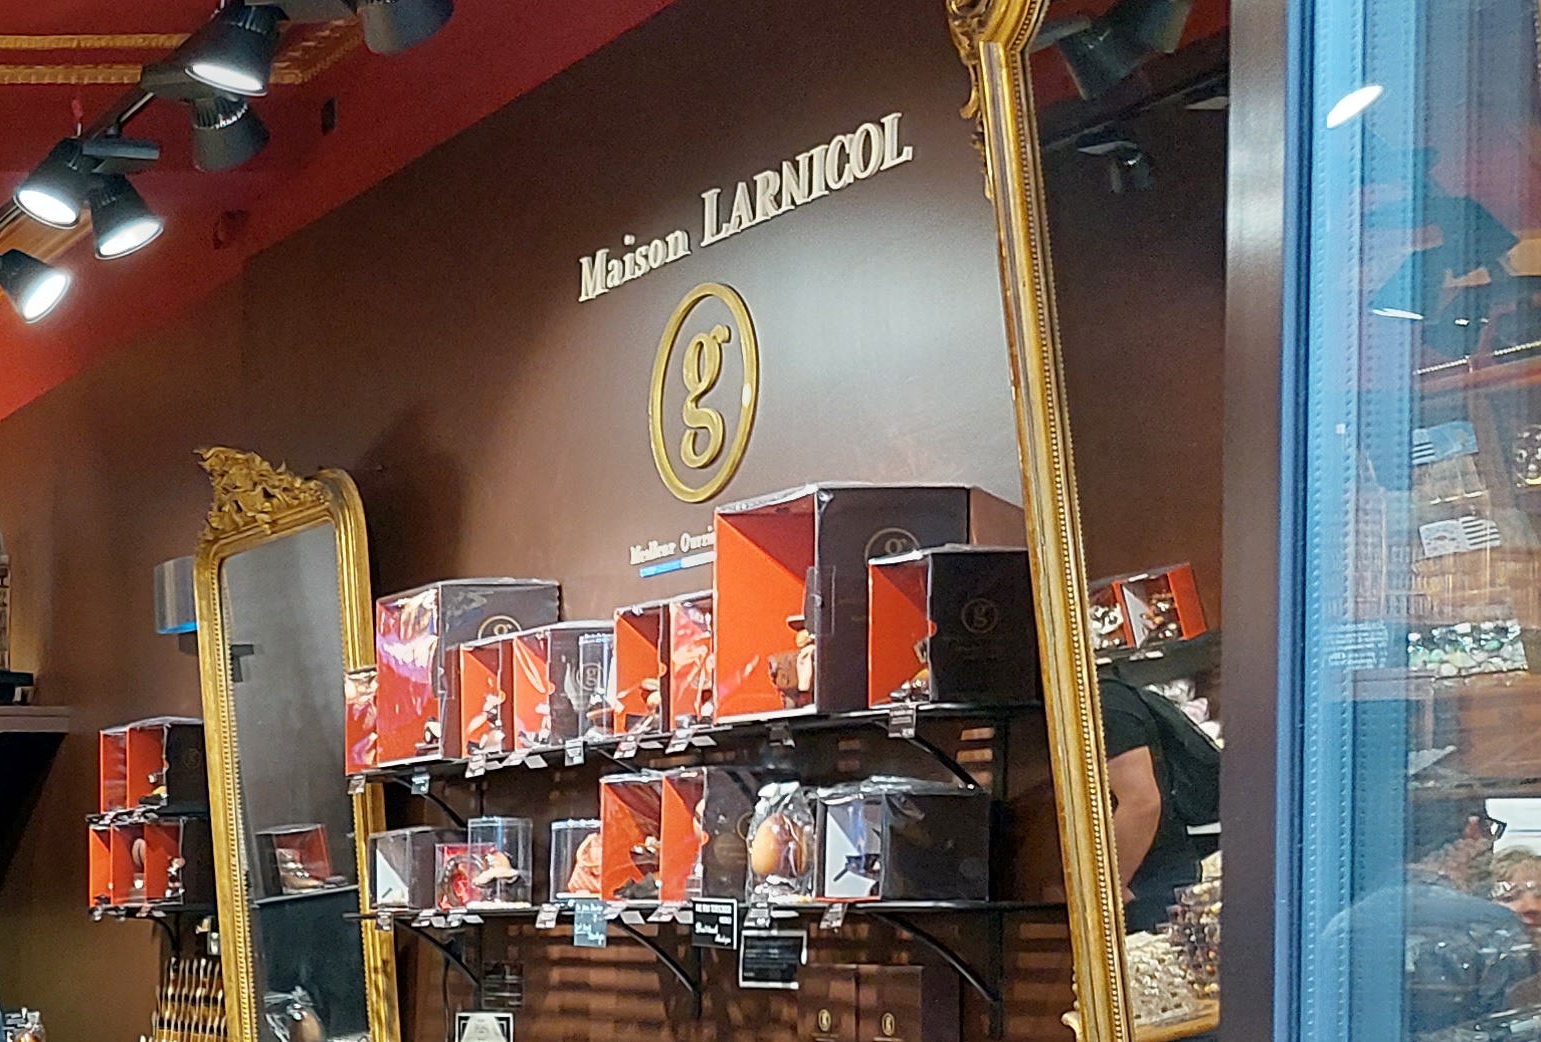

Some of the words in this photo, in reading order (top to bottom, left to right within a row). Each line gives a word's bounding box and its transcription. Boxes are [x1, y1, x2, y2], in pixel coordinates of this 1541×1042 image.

[579, 230, 692, 302] Maison
[700, 112, 913, 247] LARNICOL
[681, 323, 730, 468] g
